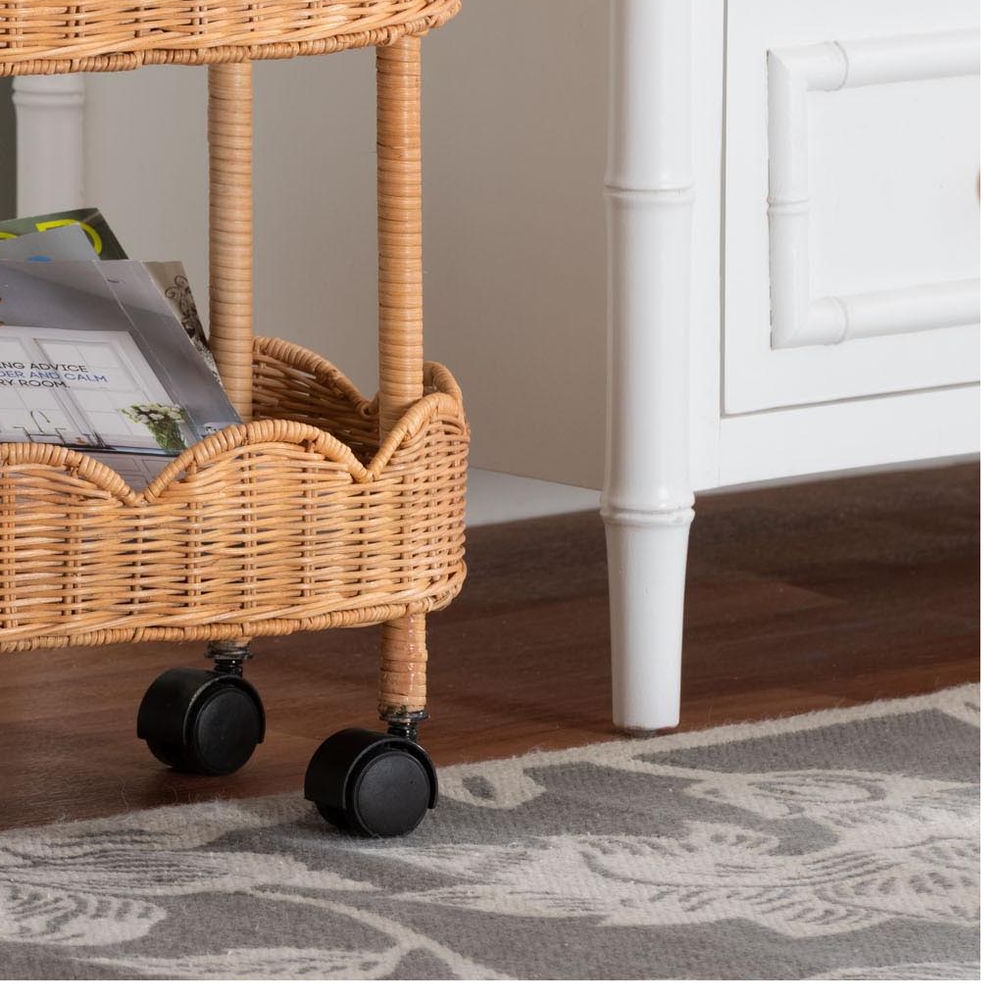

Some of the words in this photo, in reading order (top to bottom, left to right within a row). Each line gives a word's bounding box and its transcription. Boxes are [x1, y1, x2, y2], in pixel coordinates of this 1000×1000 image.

[30, 362, 89, 373] ADVICE
[29, 370, 60, 380] AND
[64, 372, 108, 383] CALM
[20, 380, 71, 389] ROOM.
